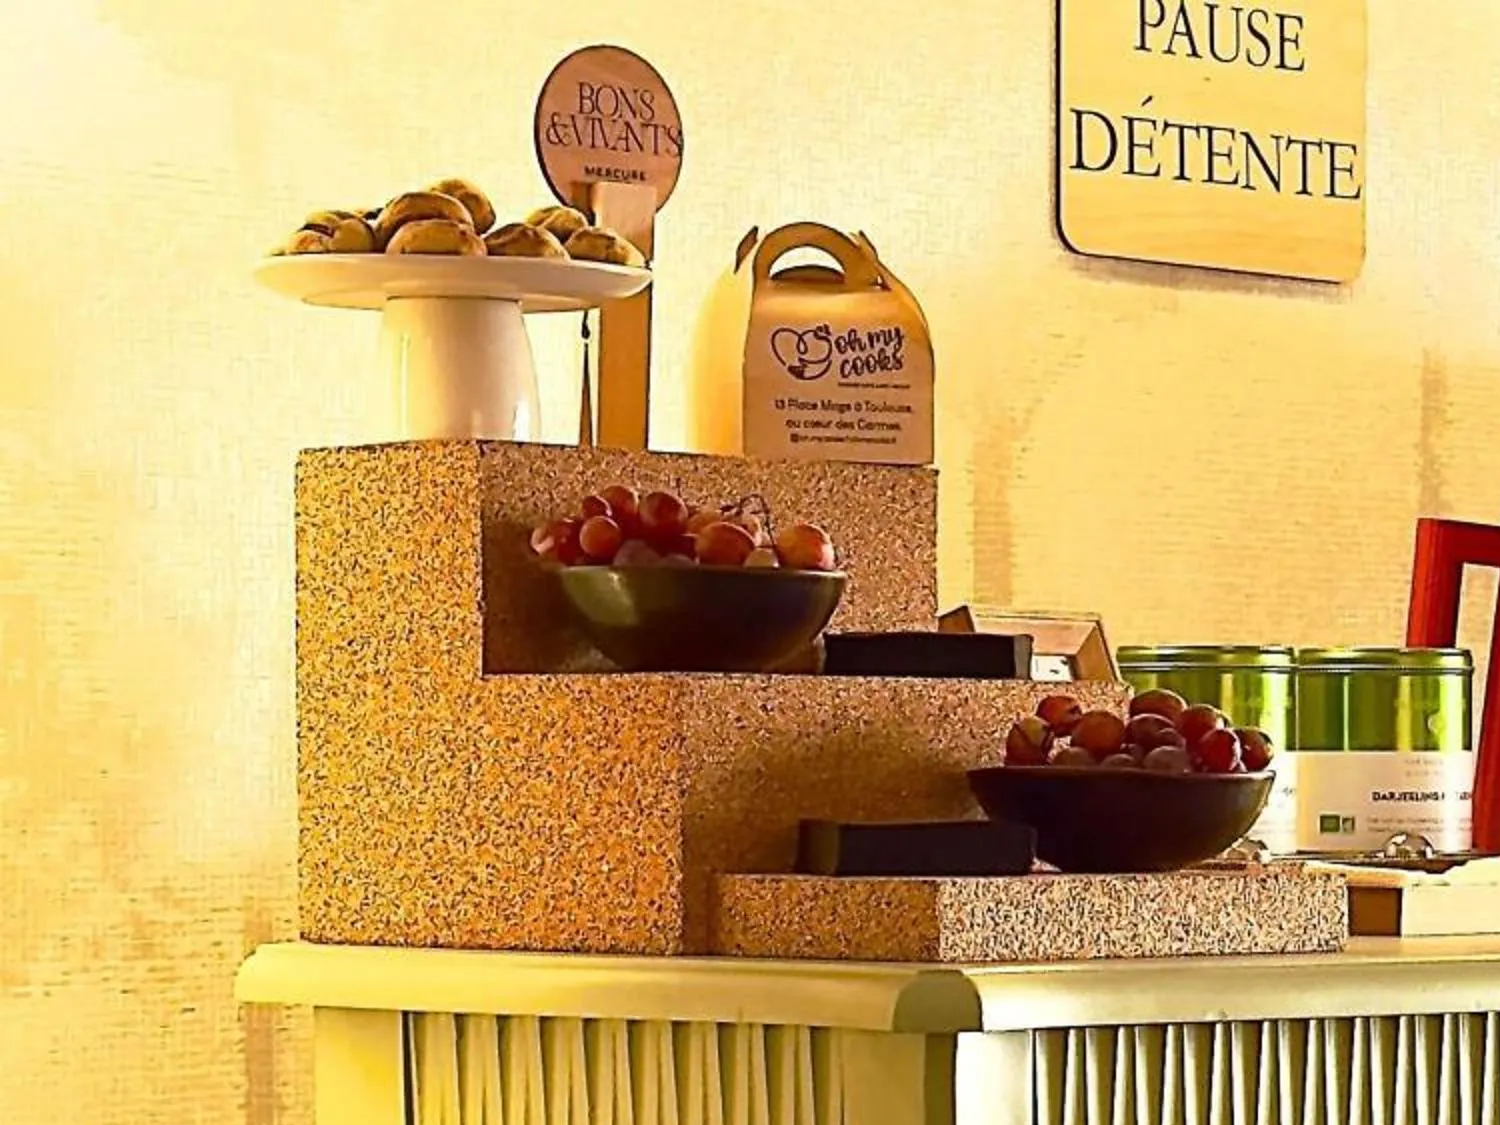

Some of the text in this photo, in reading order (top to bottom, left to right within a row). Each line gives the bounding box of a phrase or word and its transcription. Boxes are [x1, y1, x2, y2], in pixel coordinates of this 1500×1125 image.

[1134, 0, 1306, 72] PAUSE
[577, 81, 656, 122] BONS
[1068, 95, 1362, 200] DÉTENTE
[584, 165, 647, 182] MERCURE
[834, 326, 905, 354] oh my
[840, 347, 905, 379] cooks
